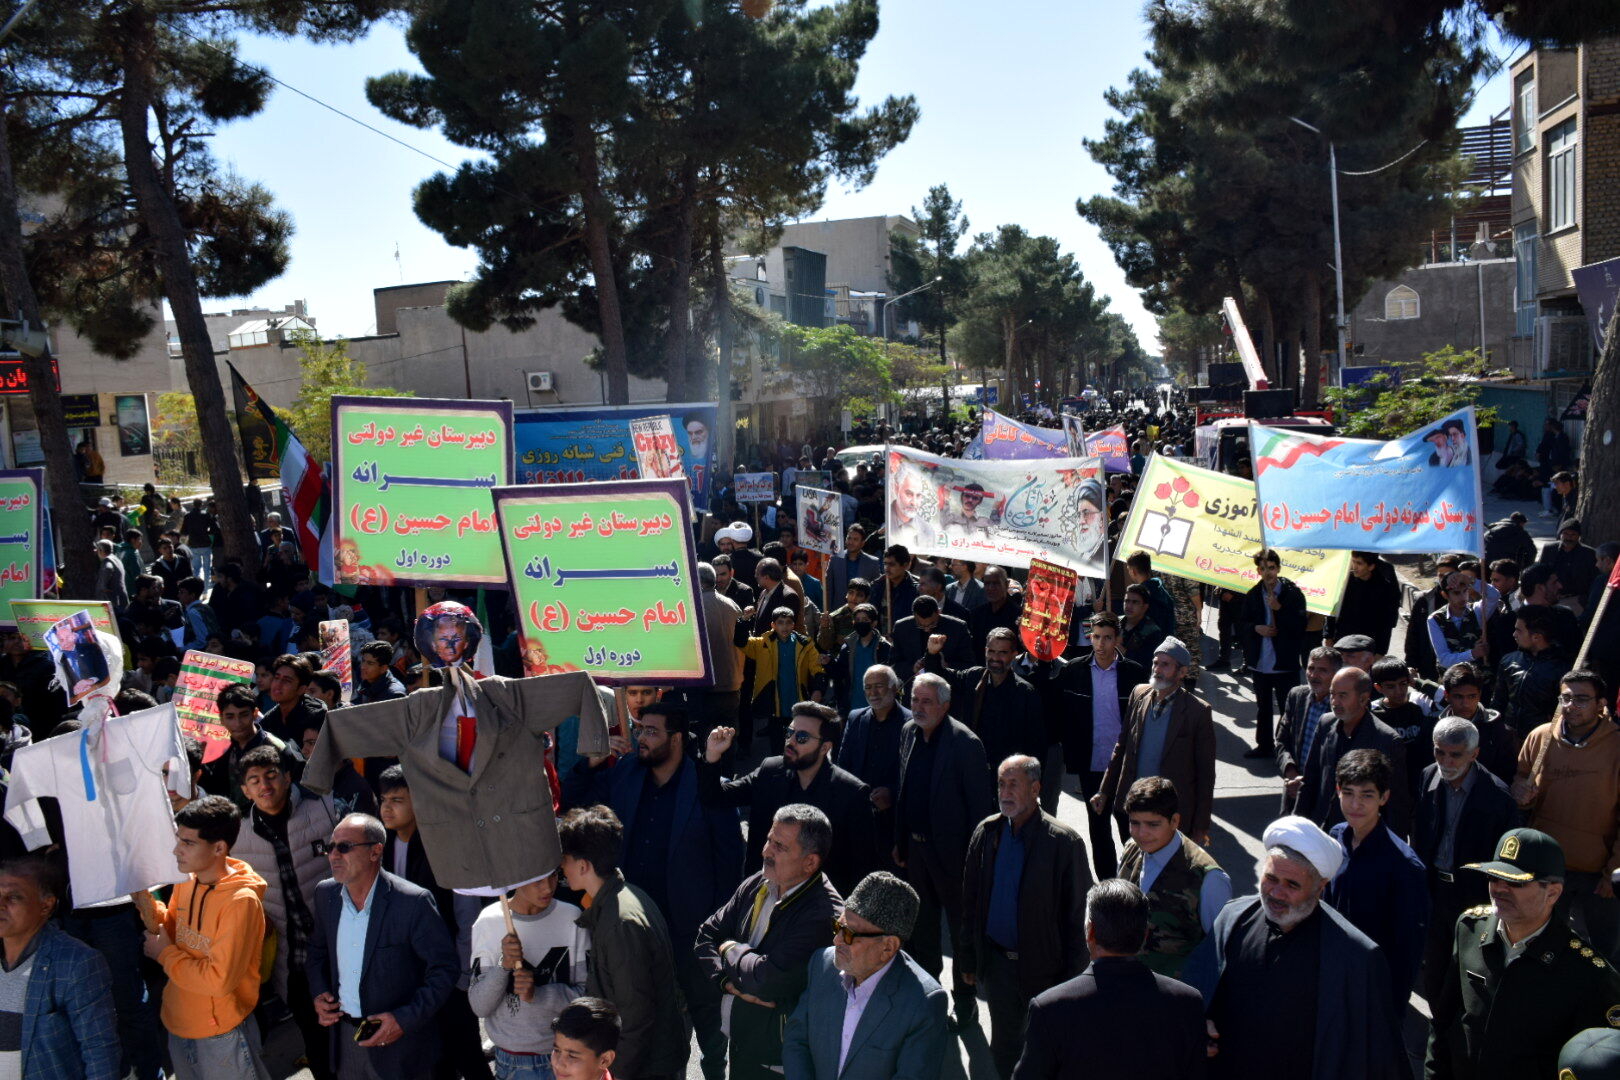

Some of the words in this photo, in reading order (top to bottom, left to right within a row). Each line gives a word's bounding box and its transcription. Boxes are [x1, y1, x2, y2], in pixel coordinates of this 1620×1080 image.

[349, 422, 395, 445] دولتی
[400, 425, 424, 446] غیر
[428, 425, 496, 449] دبیرستان
[522, 447, 559, 464] روزی
[562, 443, 595, 462] شبانه
[600, 441, 625, 463] فنی
[0, 493, 30, 510] دبیرس
[350, 503, 389, 533] (ع)
[394, 513, 451, 535] حسین
[457, 510, 498, 538] امام
[514, 513, 562, 539] دولتی
[568, 513, 594, 538] غیر
[598, 511, 672, 537] دبیرستان
[1263, 501, 1290, 530] (ع)
[1291, 507, 1332, 530] حسین
[1334, 501, 1360, 530] امام
[1361, 500, 1398, 532] دولتی
[1401, 501, 1430, 532] نمونه
[951, 537, 970, 549] رازی
[396, 549, 417, 567] اول
[421, 553, 451, 568] دوره
[1214, 565, 1239, 574] حسین
[1280, 558, 1315, 573] شهرستا
[4, 563, 29, 587] امام
[524, 555, 682, 587] پسرانه
[530, 600, 570, 631] (ع)
[576, 609, 636, 632] حسین
[643, 600, 686, 632] امام
[584, 646, 606, 666] اول
[610, 649, 641, 666] دوره
